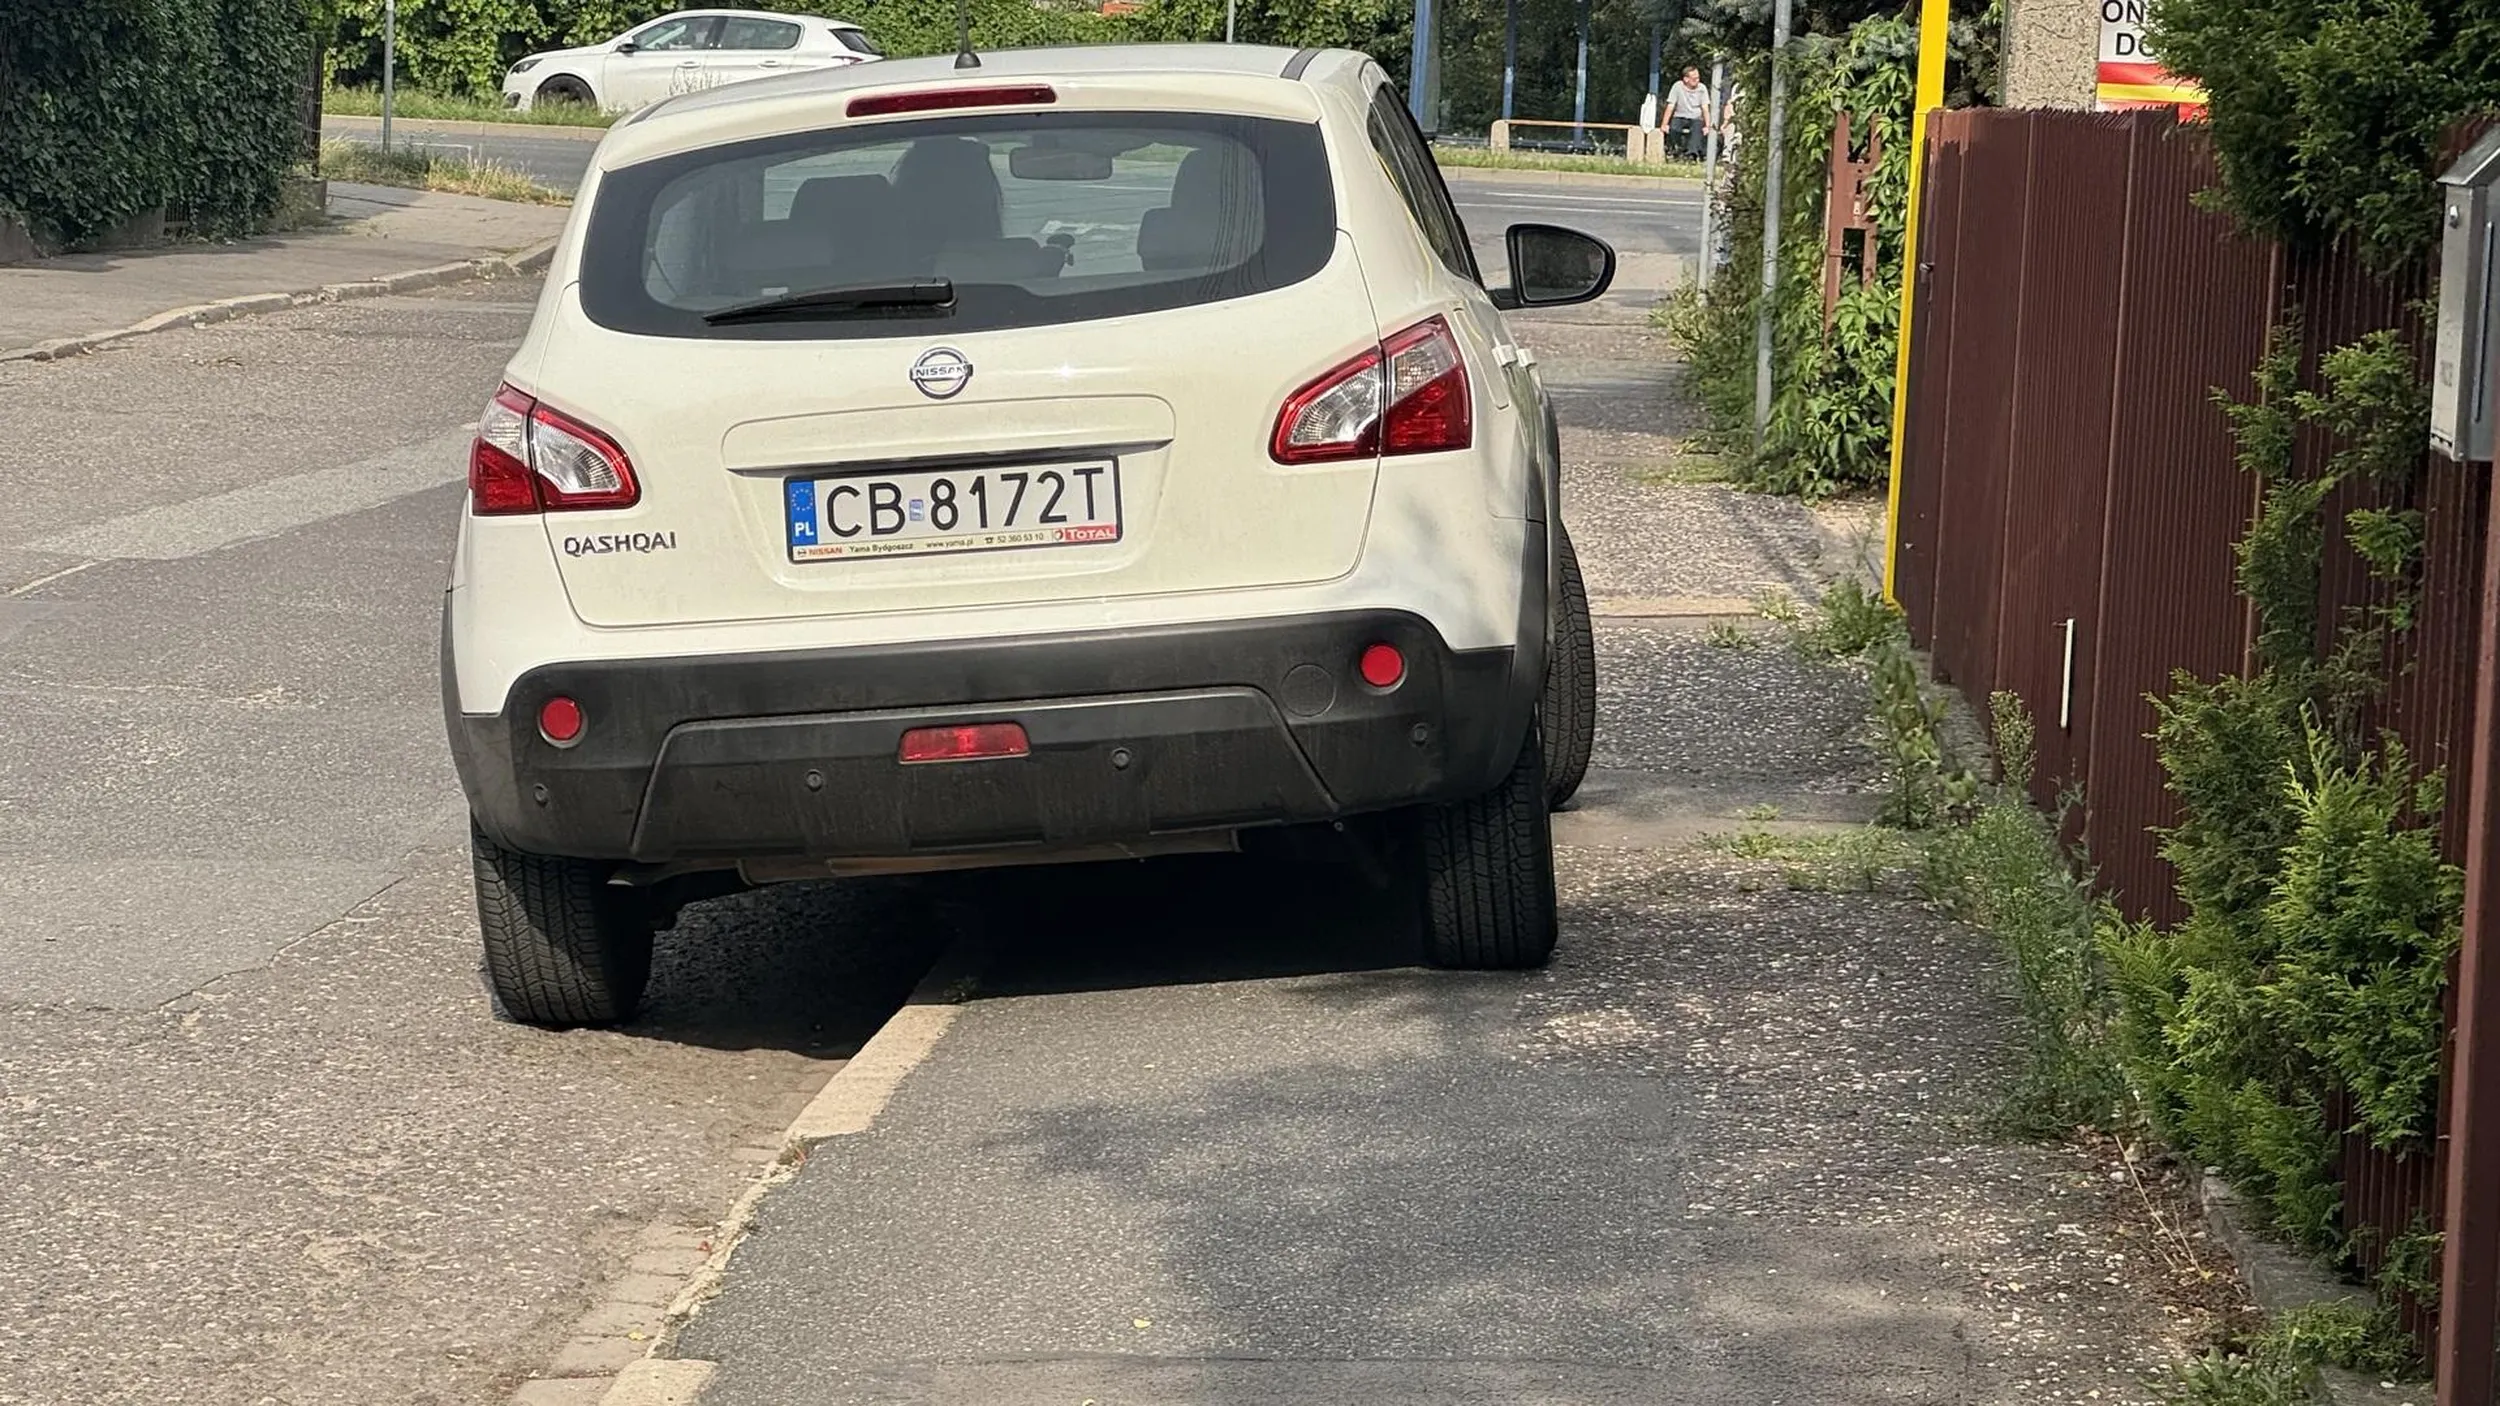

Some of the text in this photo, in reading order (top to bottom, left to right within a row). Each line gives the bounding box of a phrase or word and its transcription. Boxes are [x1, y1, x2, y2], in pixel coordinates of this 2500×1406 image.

[915, 364, 967, 377] NISSAN
[826, 467, 1105, 537] CB 8172T
[795, 522, 815, 537] PL
[809, 547, 843, 555] NISSAN
[872, 543, 914, 553] Bydgoszcz
[926, 539, 974, 548] www.yama.pl
[997, 535, 1007, 543] 52
[1023, 533, 1033, 542] 53
[1035, 533, 1044, 541] 10
[1069, 528, 1115, 540] TOTAL
[564, 531, 677, 557] QASHQAI
